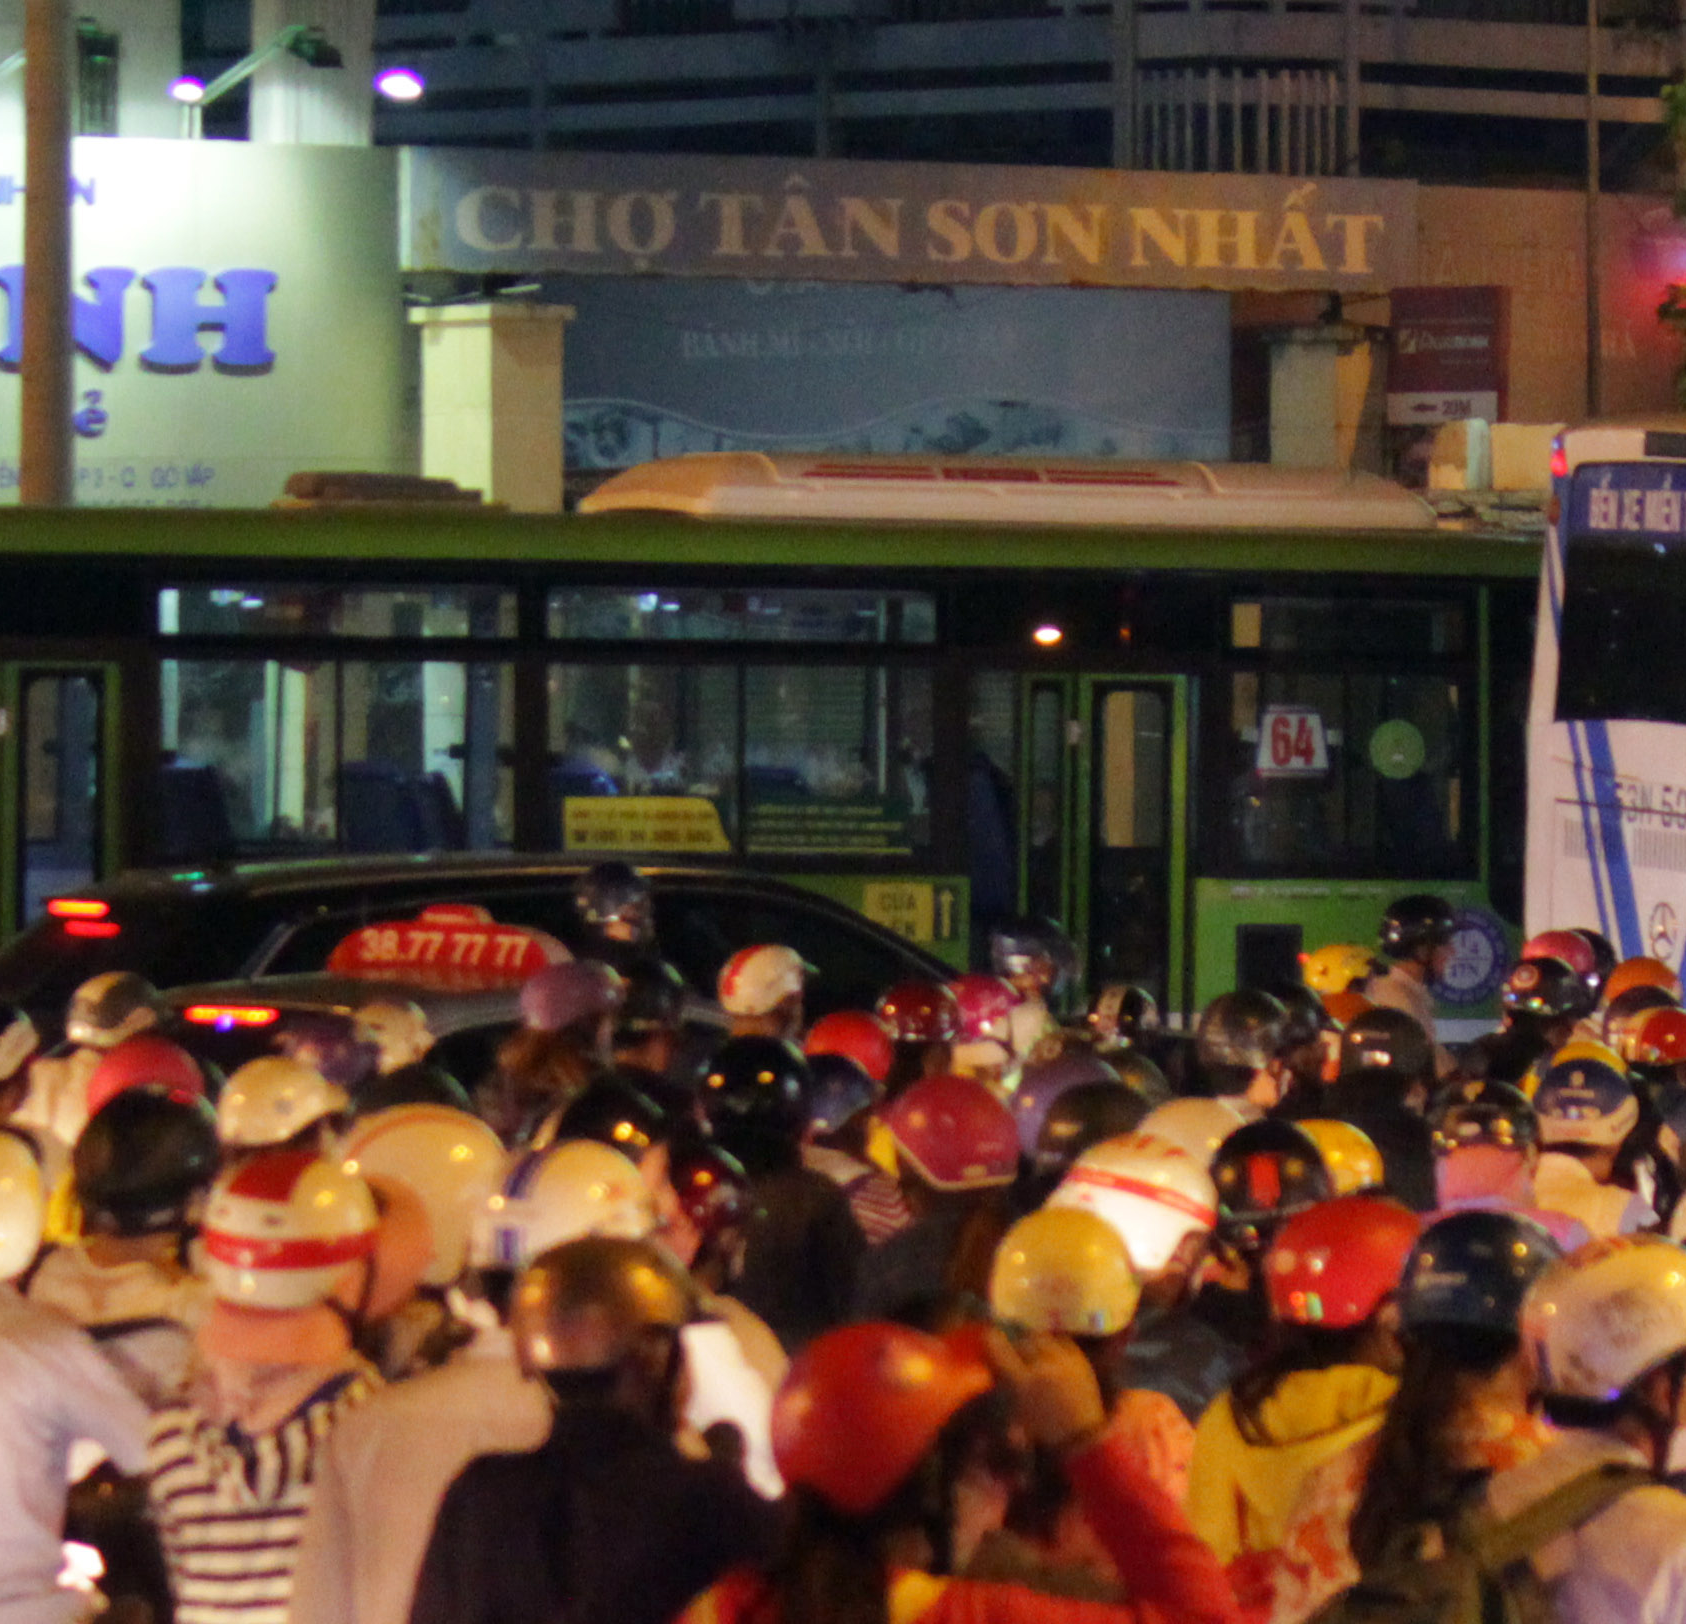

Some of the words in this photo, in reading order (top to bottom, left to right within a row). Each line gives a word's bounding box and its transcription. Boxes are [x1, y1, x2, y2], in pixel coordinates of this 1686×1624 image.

[455, 184, 679, 269] CHỢ
[695, 172, 905, 260] TÂN
[925, 199, 1108, 266] SƠN
[1128, 181, 1385, 275] NHẤT
[1269, 715, 1316, 768] 64
